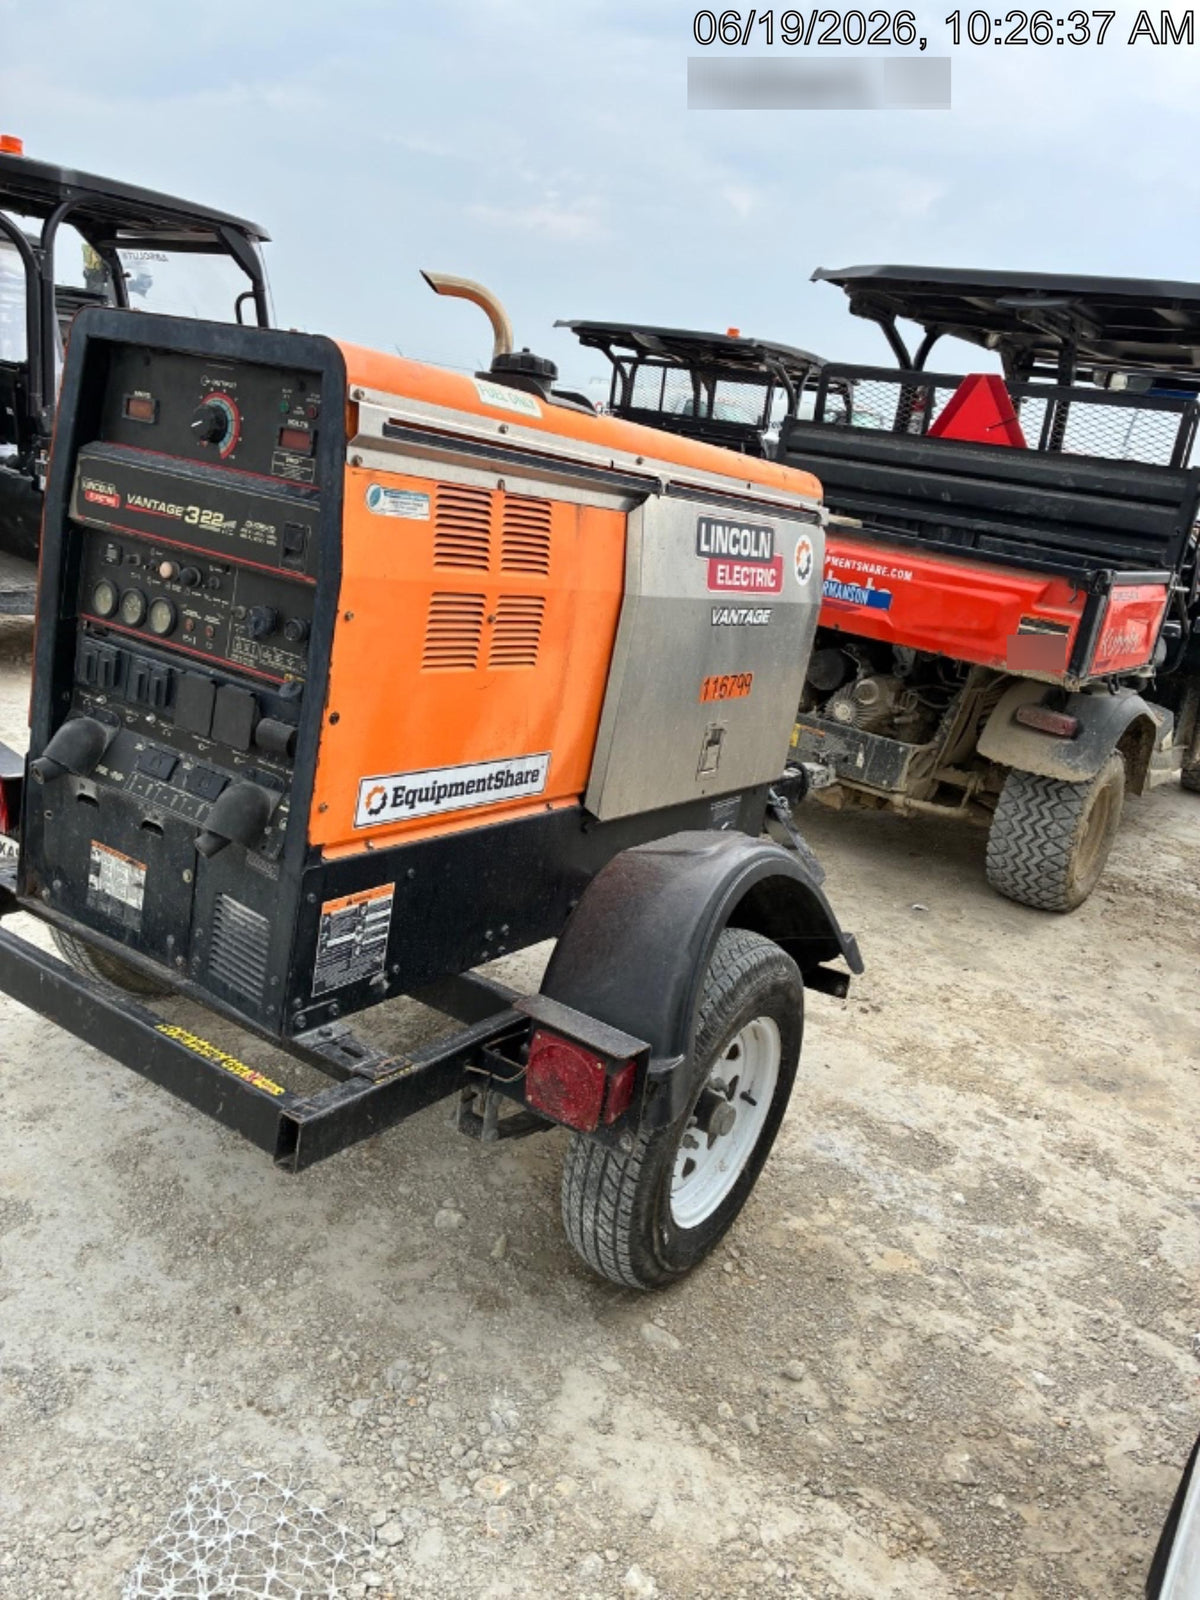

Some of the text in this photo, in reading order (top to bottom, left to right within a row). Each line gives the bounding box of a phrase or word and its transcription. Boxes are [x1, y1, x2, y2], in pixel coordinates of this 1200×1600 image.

[126, 493, 184, 517] VANTAGE
[184, 505, 225, 527] 322
[700, 521, 771, 559] LINCOLN
[716, 564, 777, 588] ELECTRIC
[711, 606, 774, 627] VANTAGE
[703, 673, 753, 701] 116799
[390, 768, 541, 810] EquipmentShare
